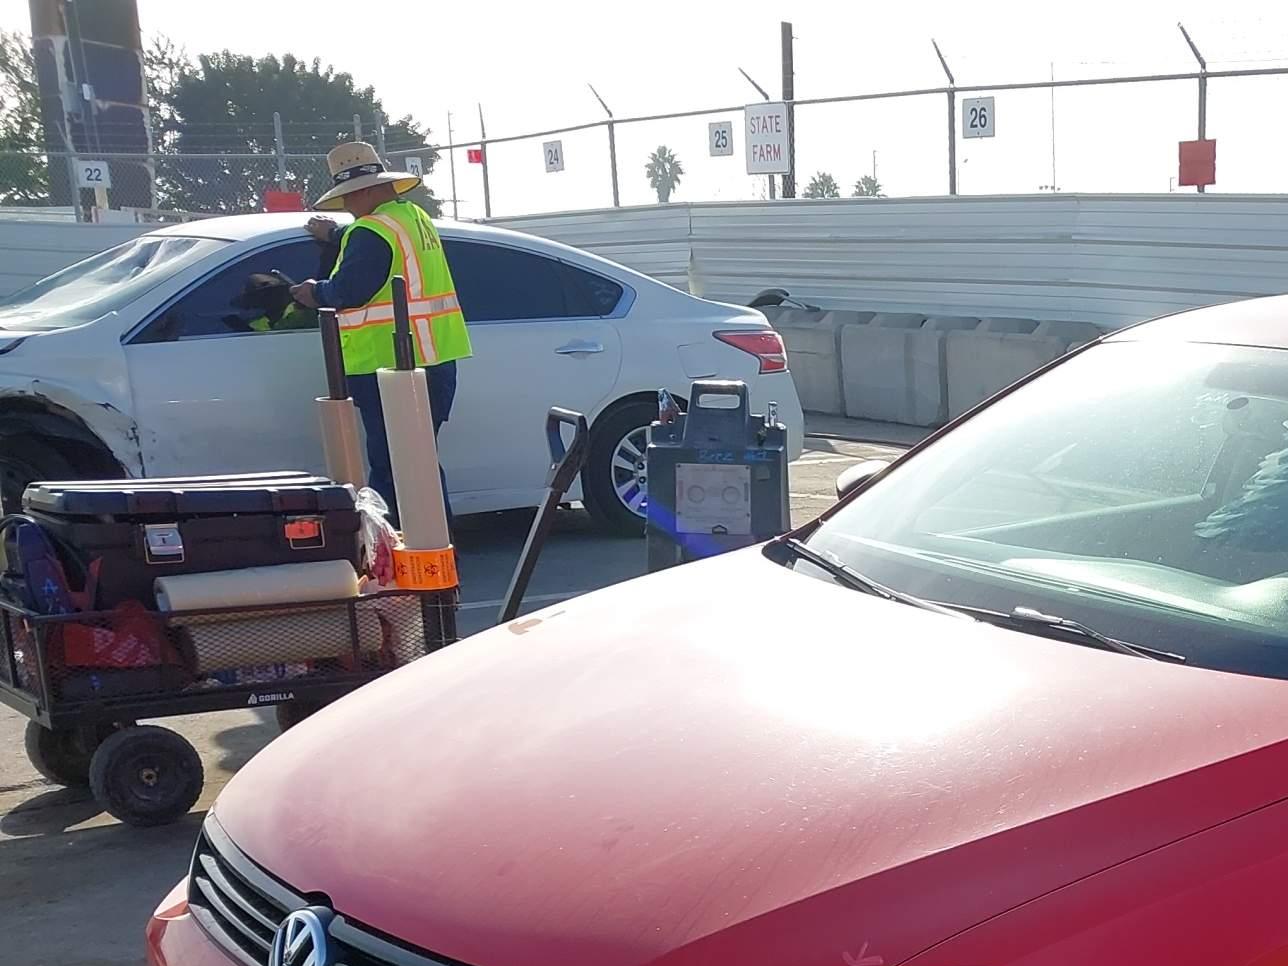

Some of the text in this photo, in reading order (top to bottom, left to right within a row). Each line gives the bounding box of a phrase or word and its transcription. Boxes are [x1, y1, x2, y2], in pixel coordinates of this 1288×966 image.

[750, 115, 782, 134] STATE
[969, 106, 987, 129] 26
[714, 130, 728, 148] 25
[547, 148, 559, 165] 24
[752, 143, 781, 162] FARM
[84, 167, 102, 182] 22
[258, 692, 295, 702] GORILLA
